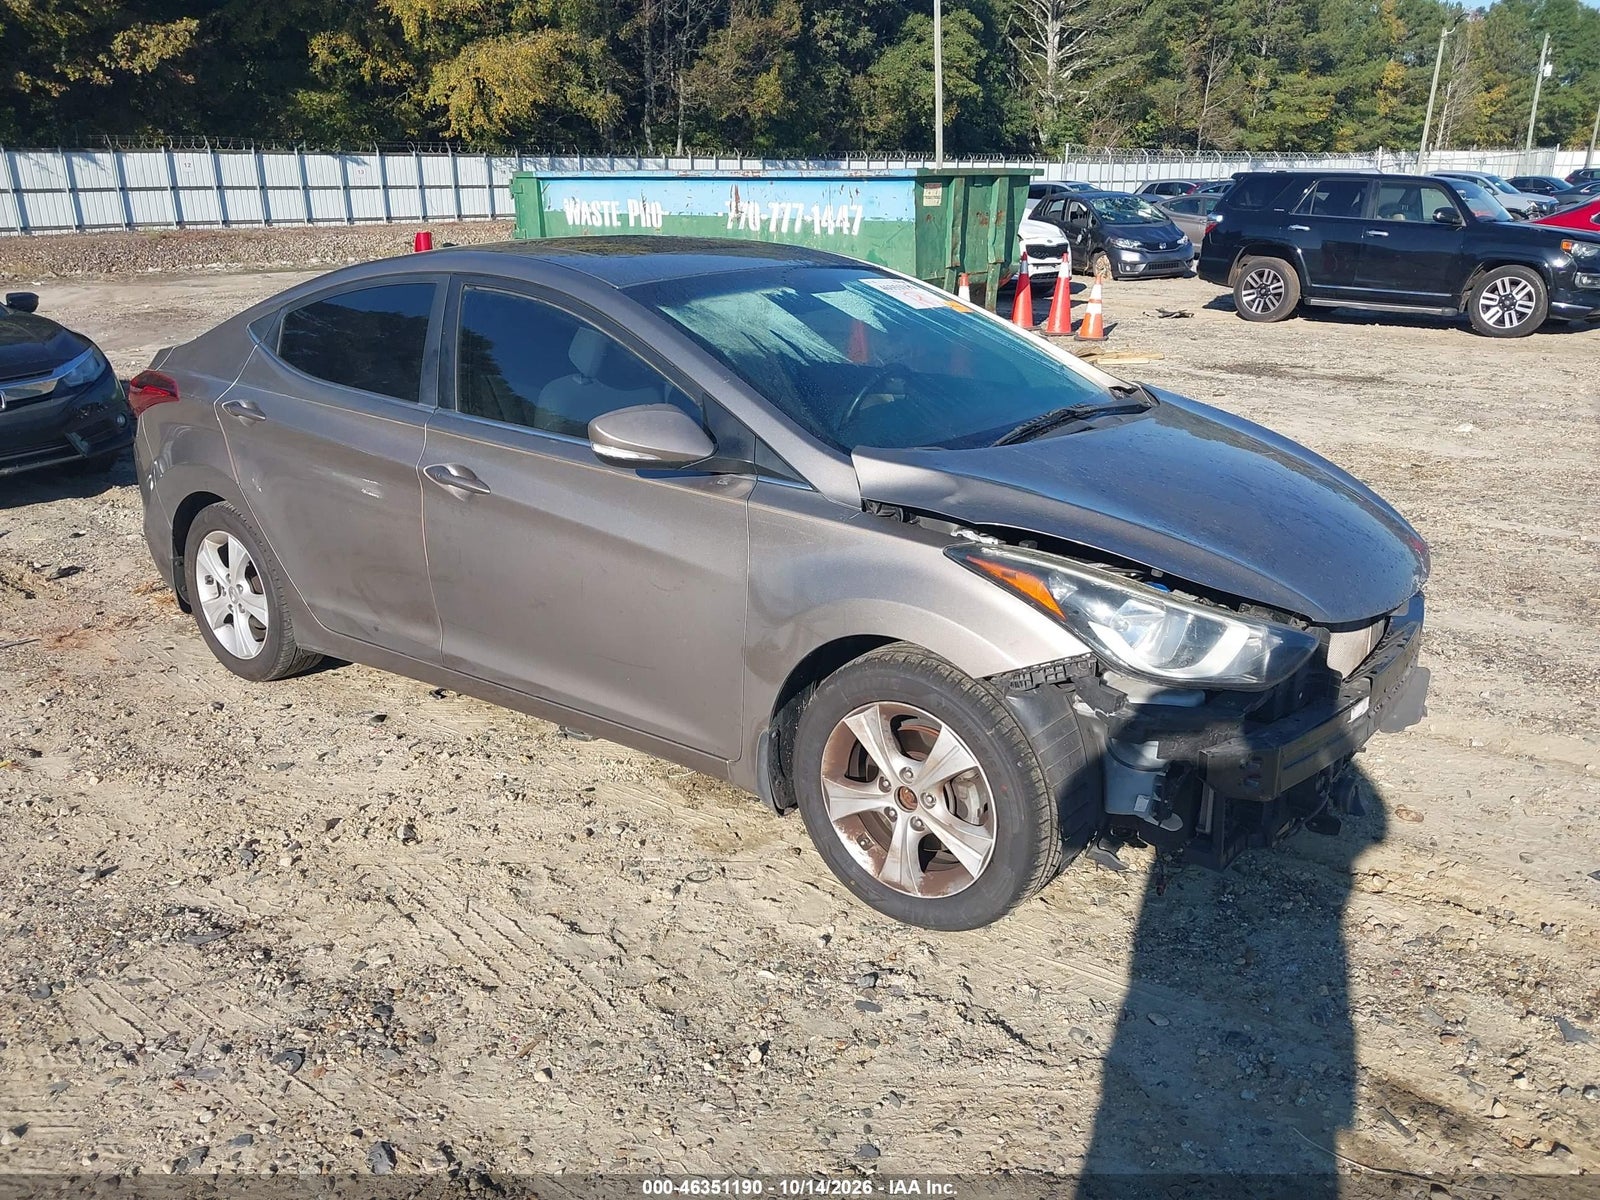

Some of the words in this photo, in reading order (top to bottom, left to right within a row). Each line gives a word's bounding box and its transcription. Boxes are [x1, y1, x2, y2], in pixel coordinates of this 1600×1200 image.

[563, 198, 622, 227] WASTE
[627, 199, 663, 228] PRO
[725, 200, 863, 235] 770-777-1447
